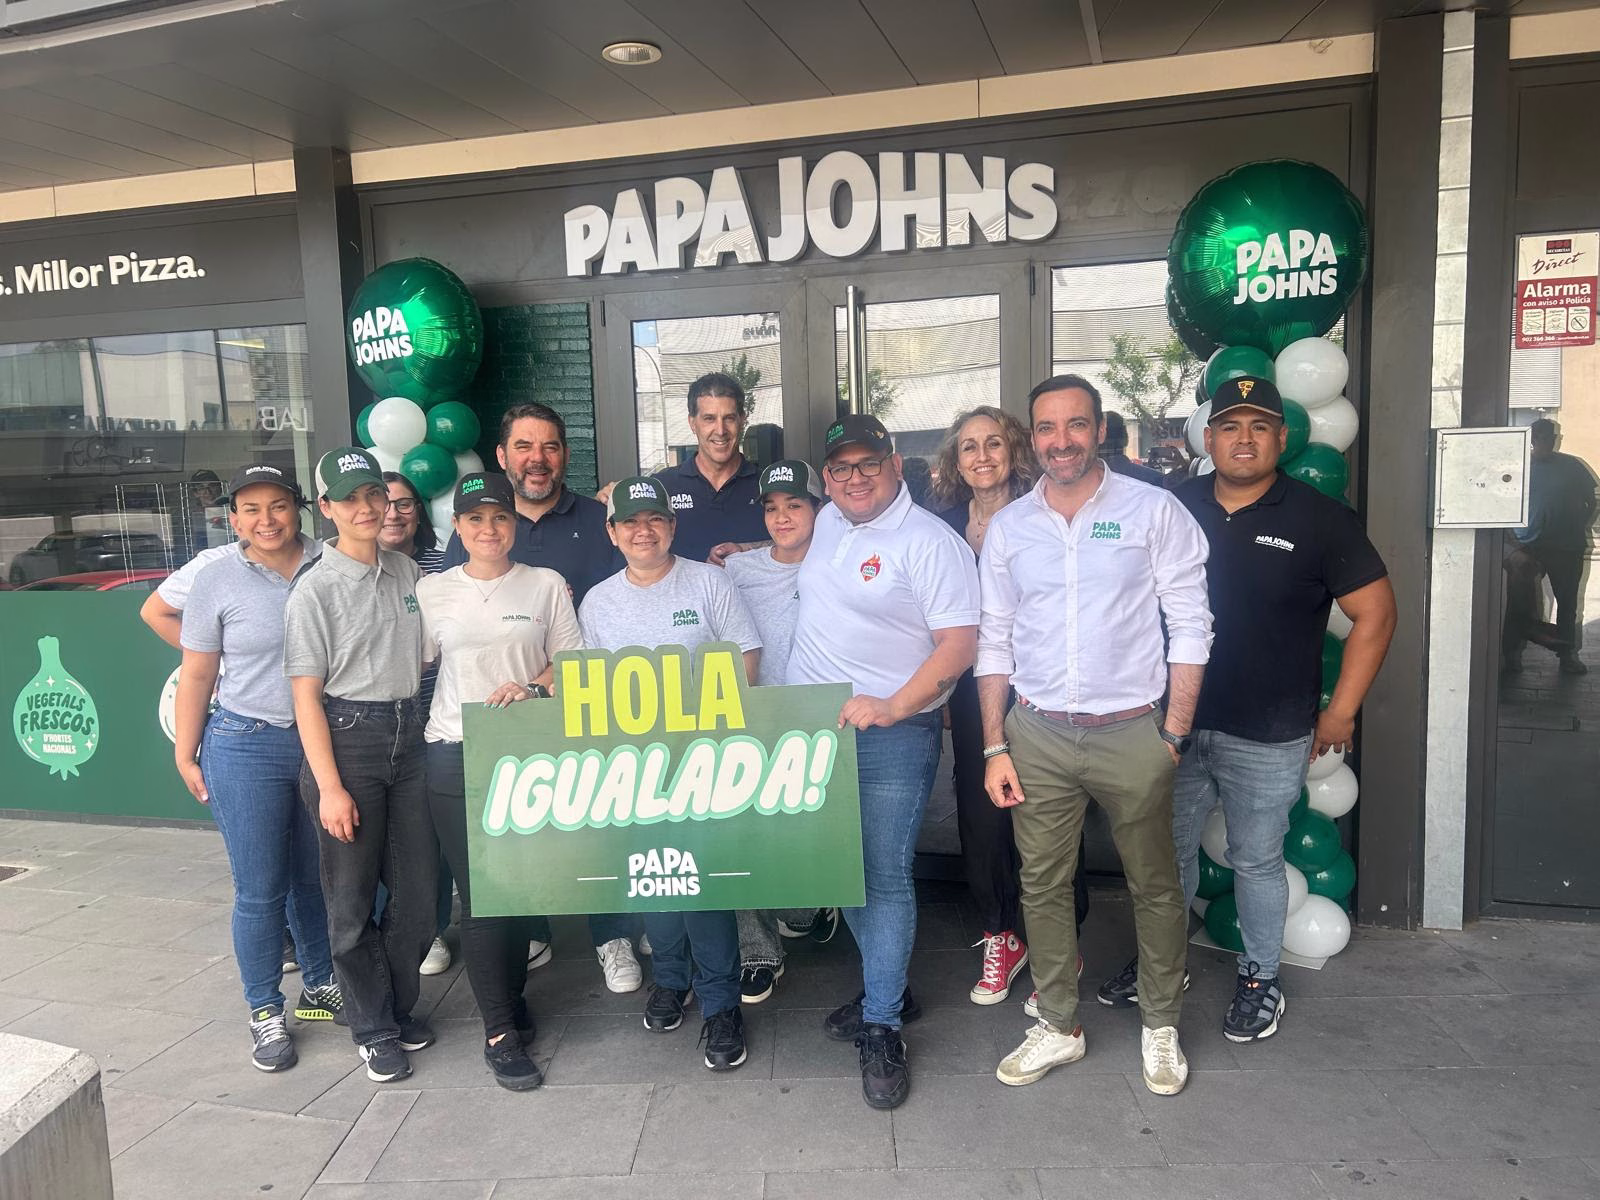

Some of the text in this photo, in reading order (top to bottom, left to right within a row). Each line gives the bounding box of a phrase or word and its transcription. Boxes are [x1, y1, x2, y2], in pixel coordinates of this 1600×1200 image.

[563, 166, 766, 277] PAPA
[767, 150, 1058, 264] JOHNS
[1236, 229, 1338, 274] PAPA
[1532, 252, 1586, 275] Direct
[14, 260, 104, 295] Millor
[109, 252, 206, 285] Pizza.
[1233, 268, 1338, 304] JOHNS
[1523, 283, 1591, 298] Alarma
[1566, 296, 1591, 304] Policía
[352, 307, 409, 343] PAPA
[355, 335, 414, 366] JOHNS
[337, 453, 367, 467] PAPA
[340, 461, 370, 474] JOHNS
[769, 466, 794, 477] PAPA
[462, 478, 484, 489] PAPA
[768, 474, 794, 484] JOHNS
[462, 485, 485, 495] JOHNS
[629, 482, 655, 495] PAPA
[630, 491, 657, 499] JOHNS
[671, 494, 693, 503] PAPA
[1092, 521, 1121, 531] PAPA
[1090, 531, 1121, 539] JOHNS
[1256, 535, 1295, 549] PAPA JOHNS
[403, 594, 416, 606] PA
[672, 609, 699, 620] PAPA
[672, 618, 700, 627] JOHNS
[26, 692, 86, 711] VEGETALS
[561, 651, 746, 738] HOLA
[20, 709, 95, 736] FRESCOS
[486, 733, 834, 833] IGUALADA!
[628, 847, 699, 877] PAPA
[627, 876, 700, 898] JOHNS
